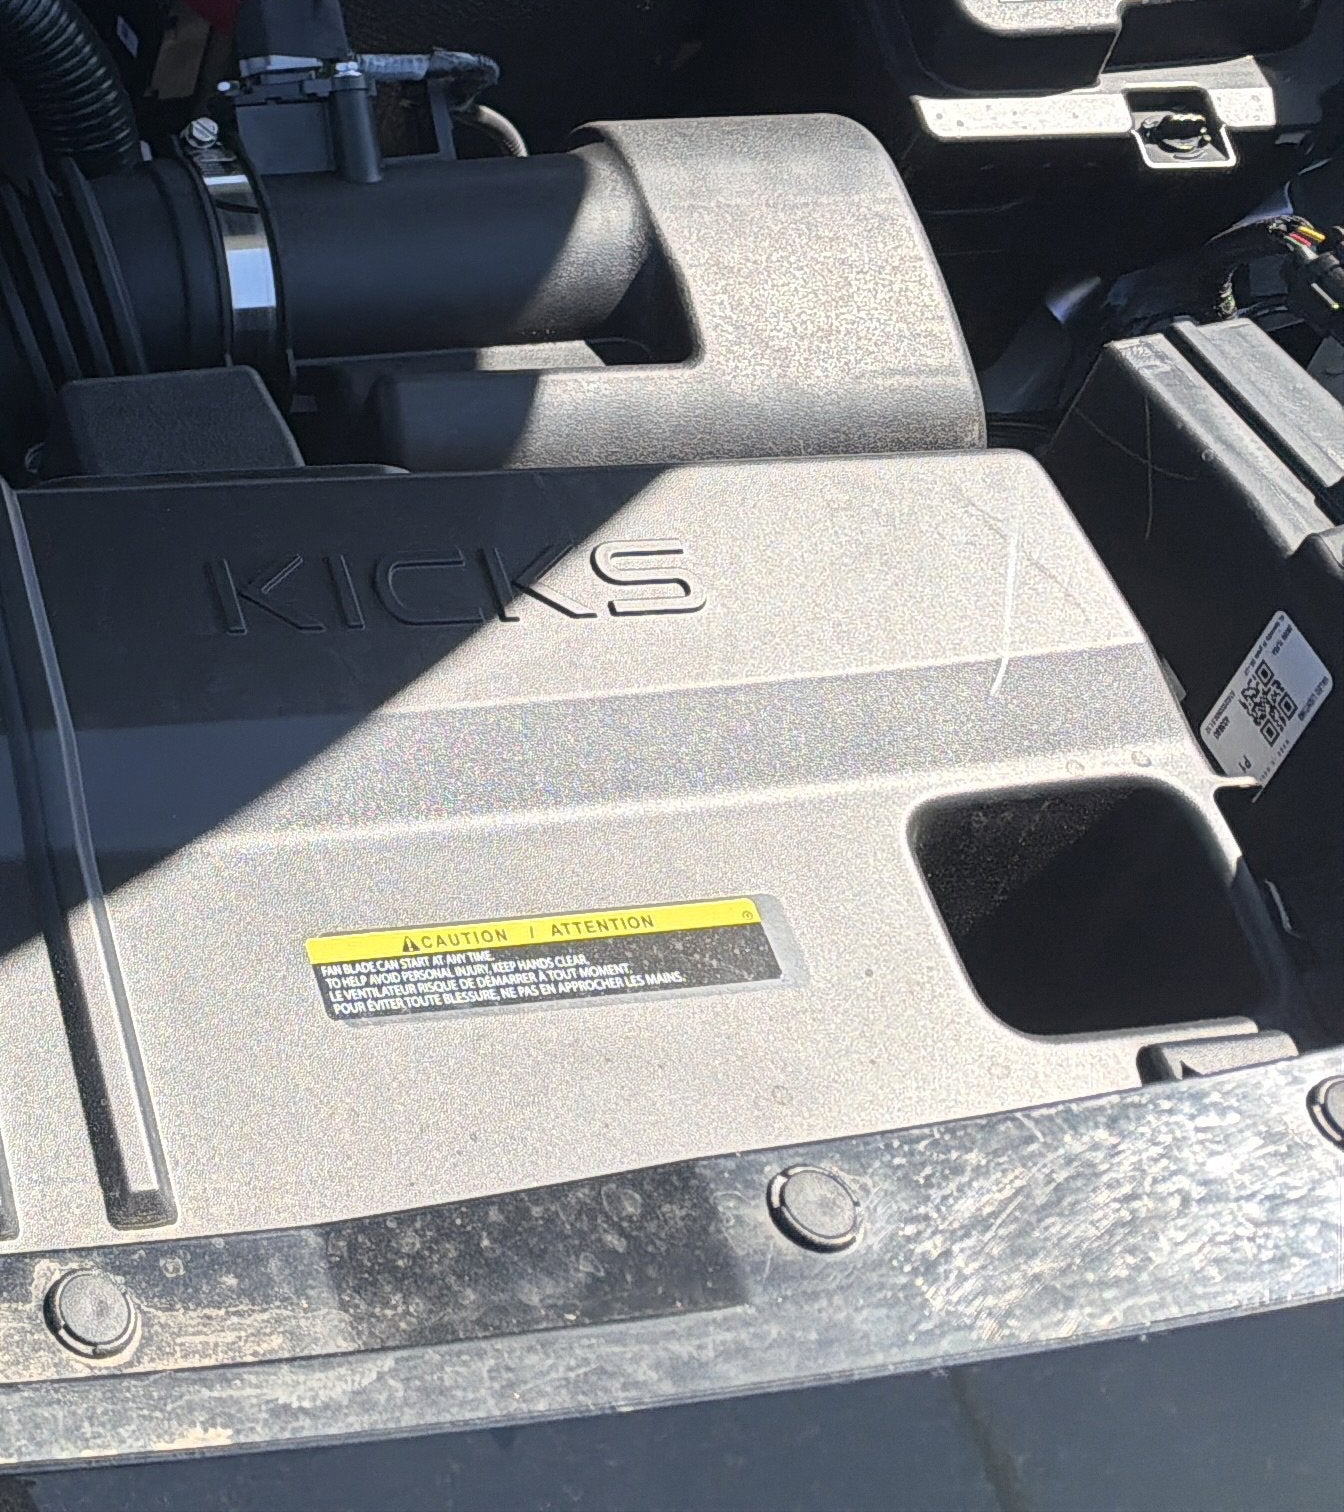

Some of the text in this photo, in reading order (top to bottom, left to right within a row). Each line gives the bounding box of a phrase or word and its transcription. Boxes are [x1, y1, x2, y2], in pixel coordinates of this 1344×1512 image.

[204, 537, 708, 636] KICKS
[421, 929, 508, 949] CAUTION
[551, 914, 655, 937] ATTENTION
[320, 950, 496, 978] FAN BLADE CAN START AT ANY TIME.
[325, 977, 341, 990] TO
[342, 974, 368, 988] HELP
[369, 970, 401, 986] AVOID
[401, 967, 455, 983] PERSONAL
[492, 959, 515, 974] KEEP
[518, 956, 554, 971] HANDS
[328, 989, 344, 1002] LE
[344, 982, 417, 1002] VENTILATEUR
[418, 979, 458, 994] RISQUE
[459, 976, 475, 990] DE
[476, 971, 536, 989] DÉMARRER
[548, 967, 577, 981] TOUT
[579, 962, 633, 978] MOMENT.
[333, 970, 687, 1015] POUR ÉVITER TOUTE BLESSURE, NE PAS EN APPROCHER LES MAINS.
